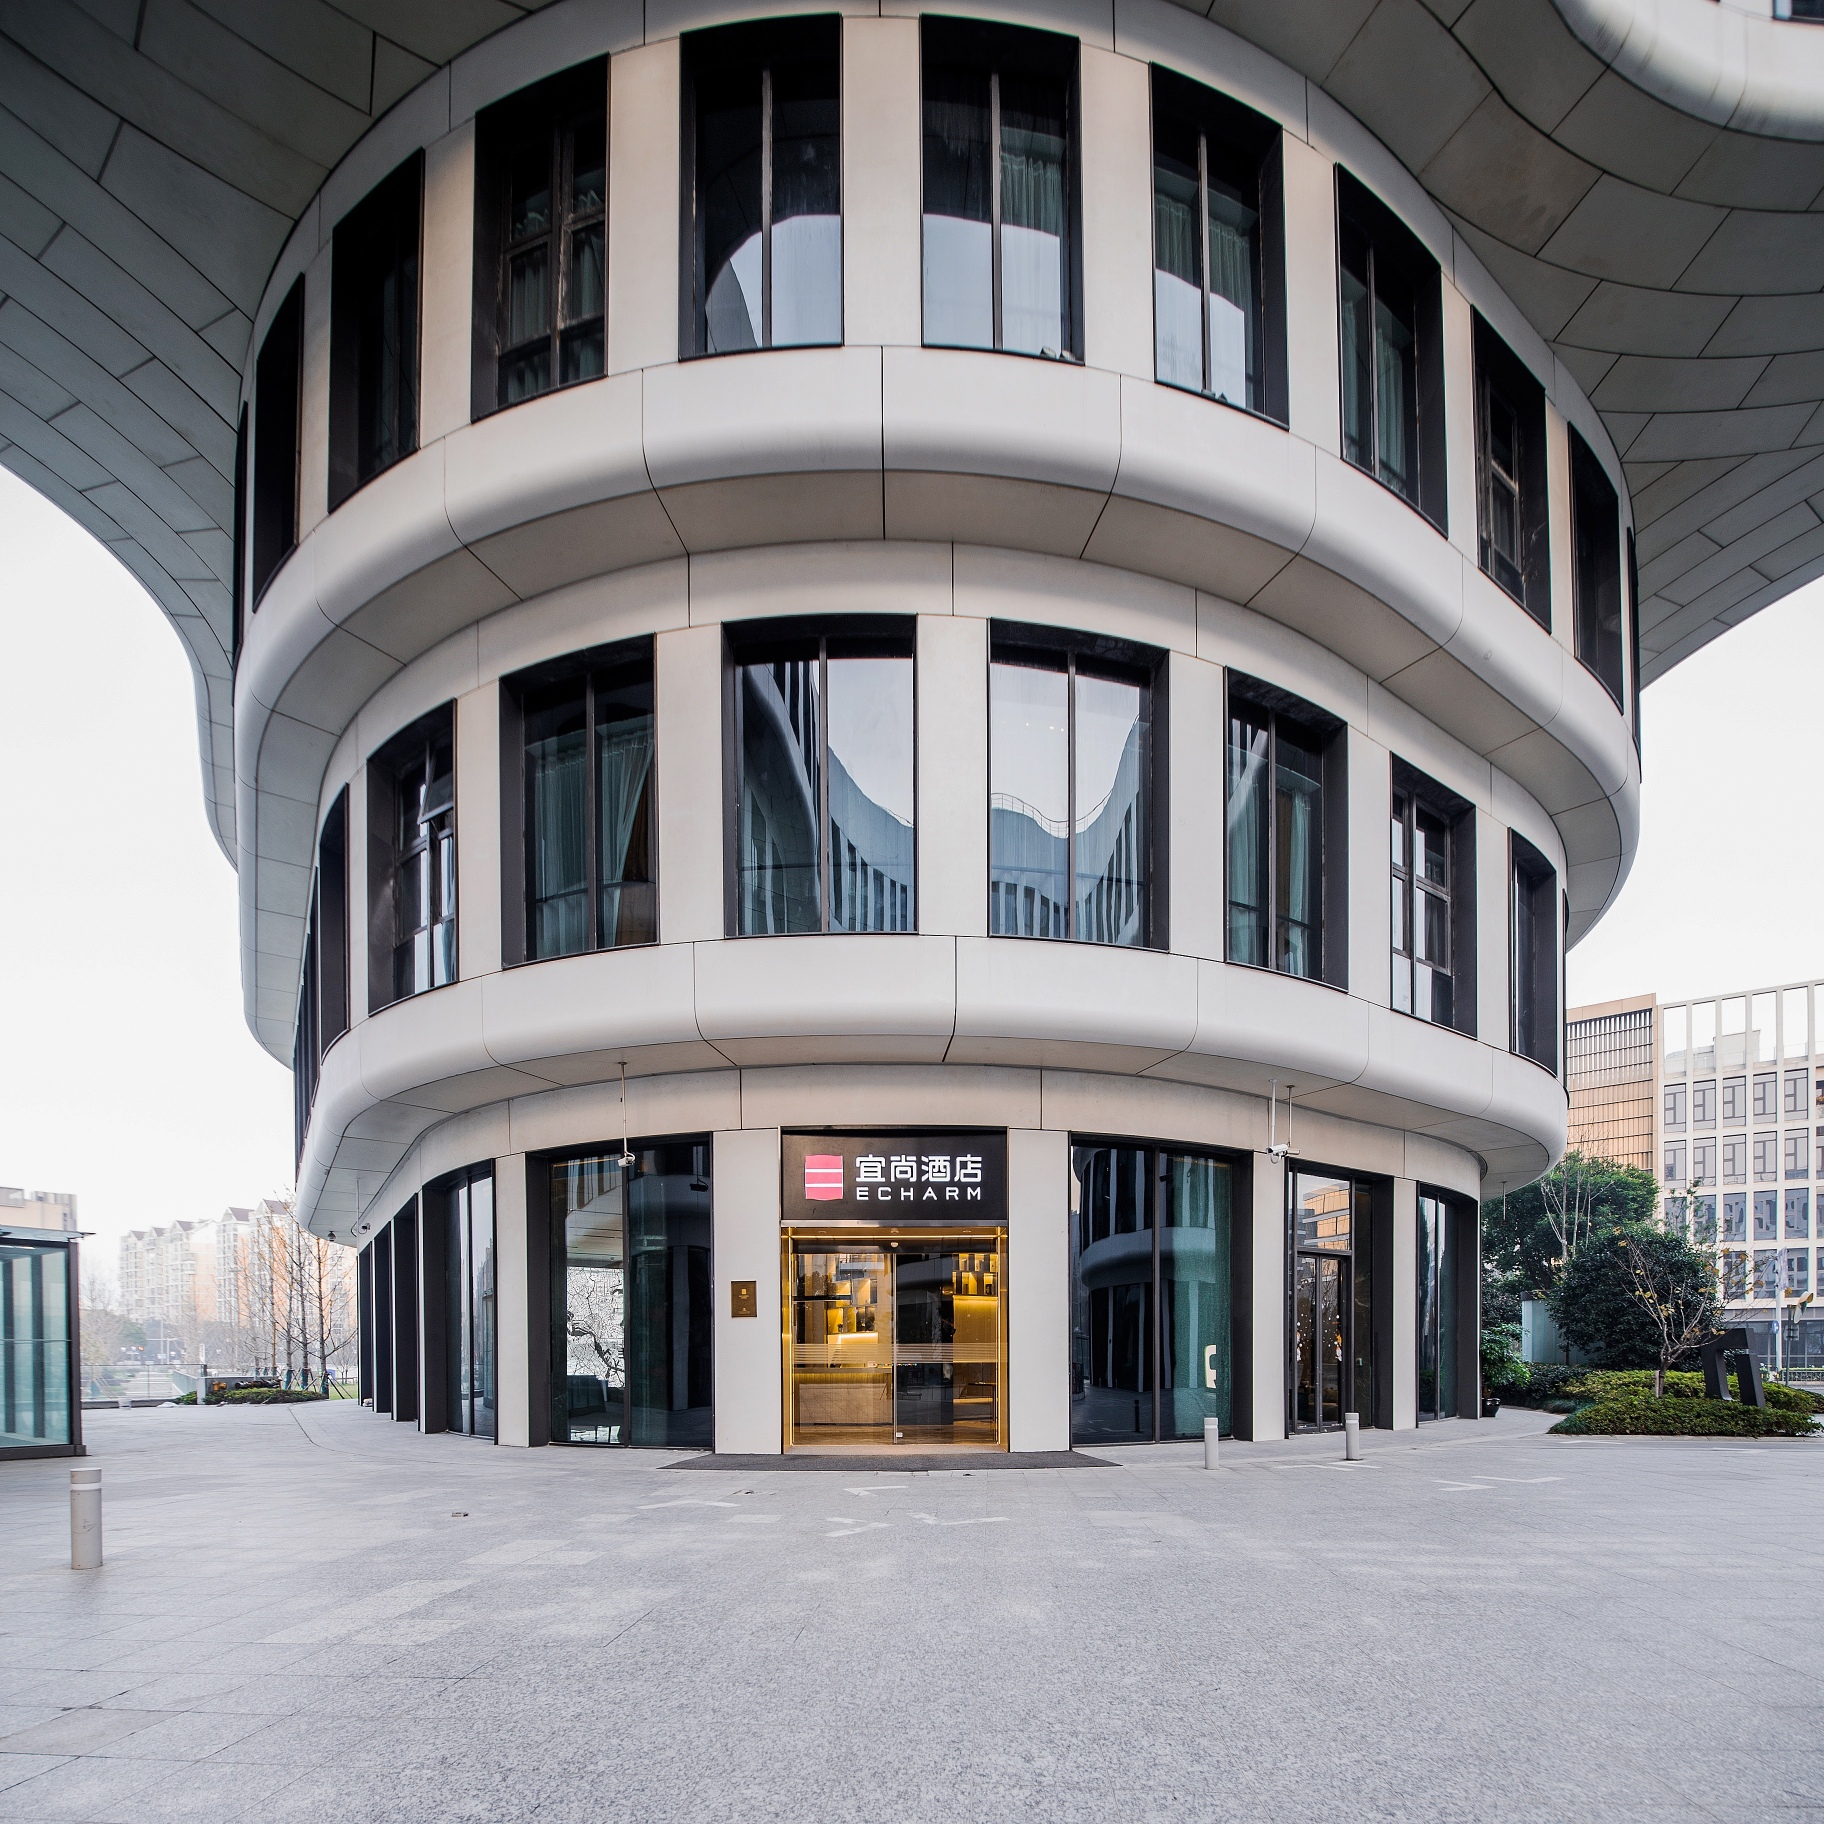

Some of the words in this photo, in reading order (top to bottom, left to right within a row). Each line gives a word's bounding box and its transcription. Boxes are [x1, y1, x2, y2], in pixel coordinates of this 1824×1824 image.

[856, 1154, 982, 1182] 宜尚酒店
[856, 1187, 981, 1200] ECHARM
